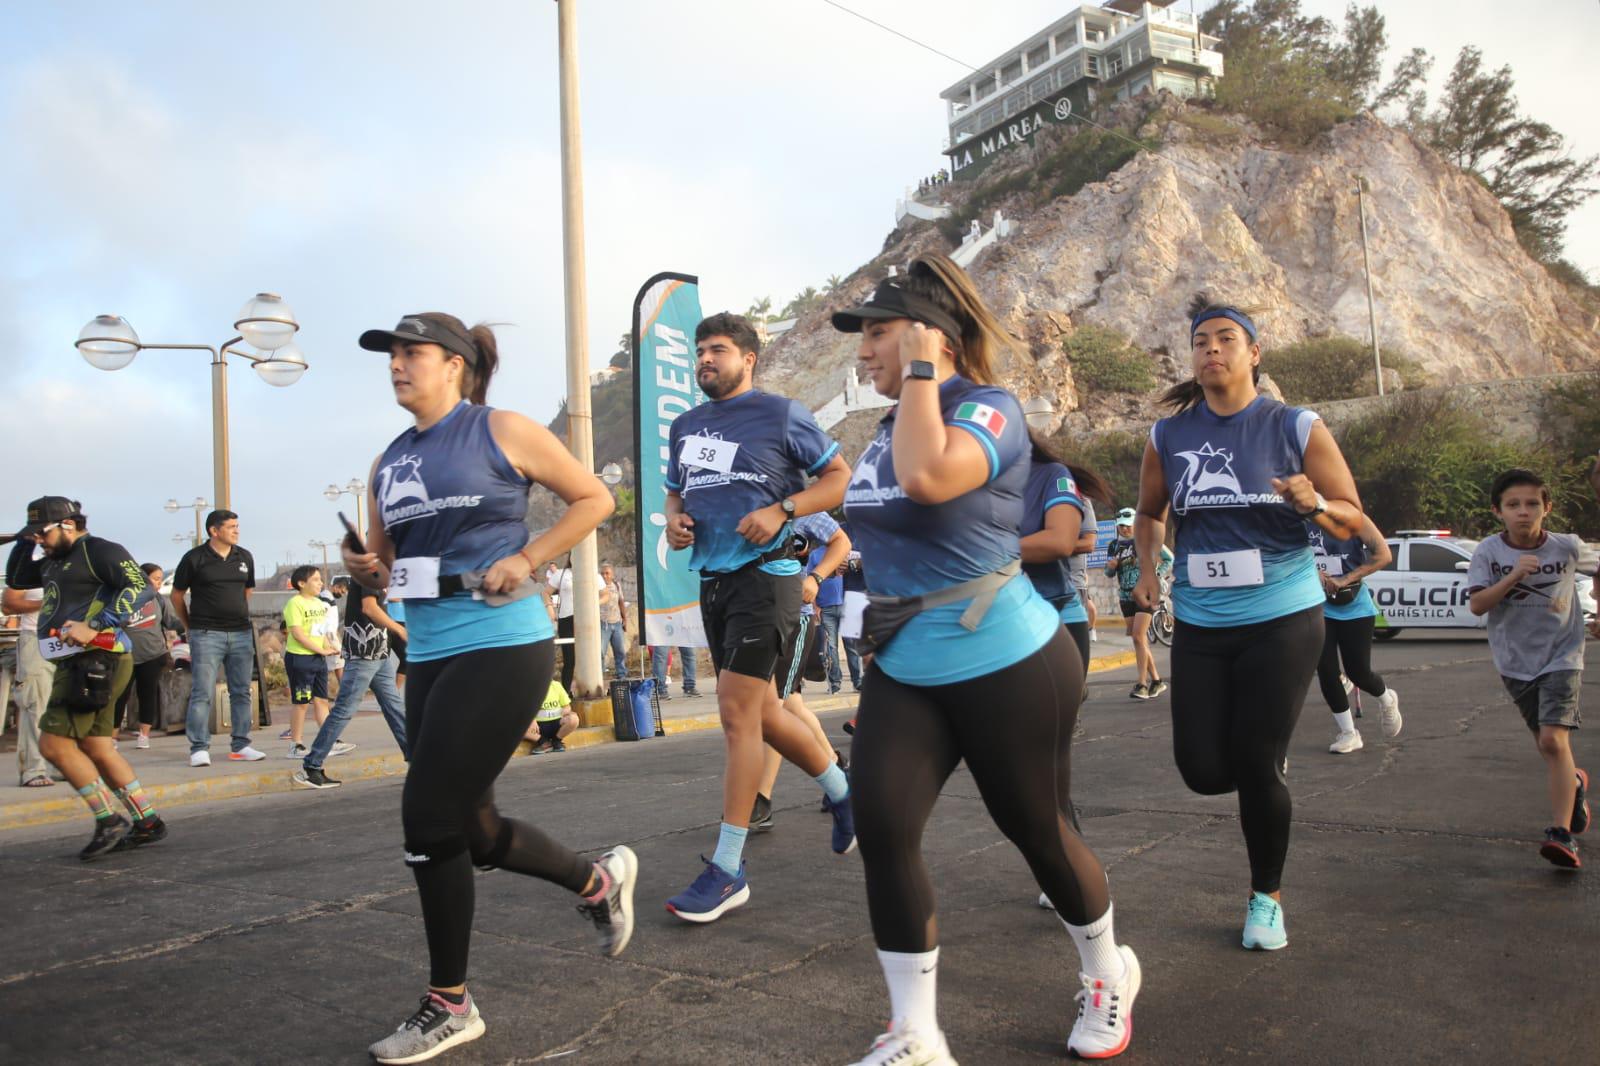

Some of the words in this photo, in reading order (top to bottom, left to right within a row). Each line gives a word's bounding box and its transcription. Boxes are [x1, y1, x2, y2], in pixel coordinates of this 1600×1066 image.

[953, 149, 974, 172] LA
[981, 111, 1043, 158] MAREA
[697, 447, 717, 463] 58
[1206, 560, 1230, 578] 51
[1380, 607, 1456, 618] TURÍSTICA
